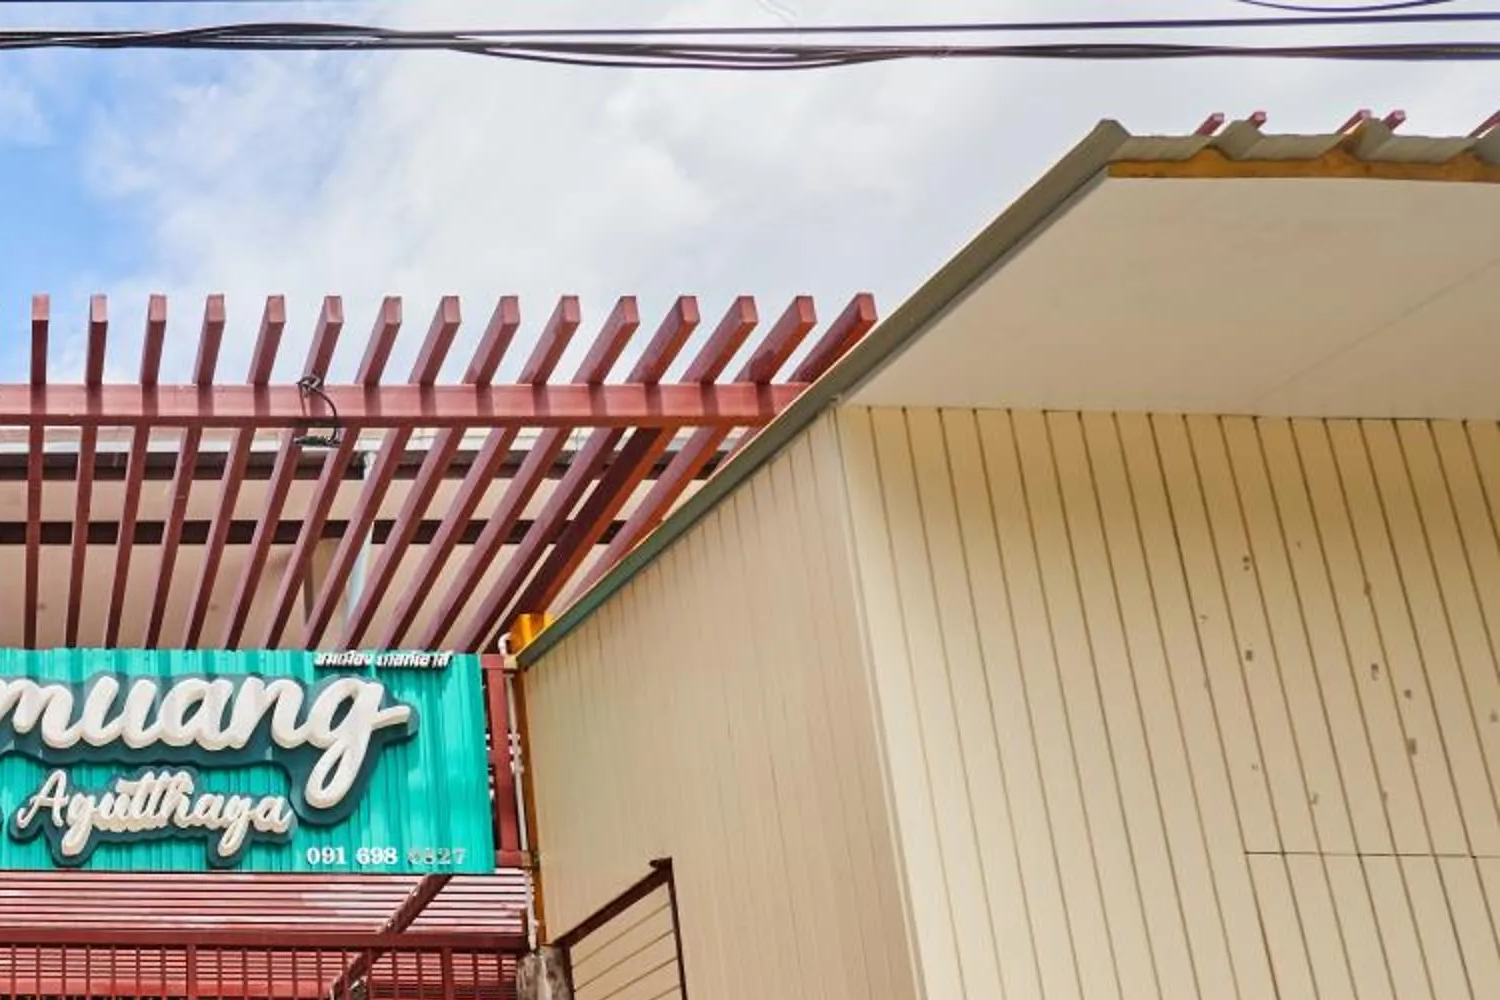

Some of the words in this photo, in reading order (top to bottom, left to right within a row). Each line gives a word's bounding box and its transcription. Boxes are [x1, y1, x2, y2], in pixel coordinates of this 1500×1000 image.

[17, 768, 295, 857] Ayutthaya
[306, 847, 346, 865] 091
[355, 847, 398, 865] 698
